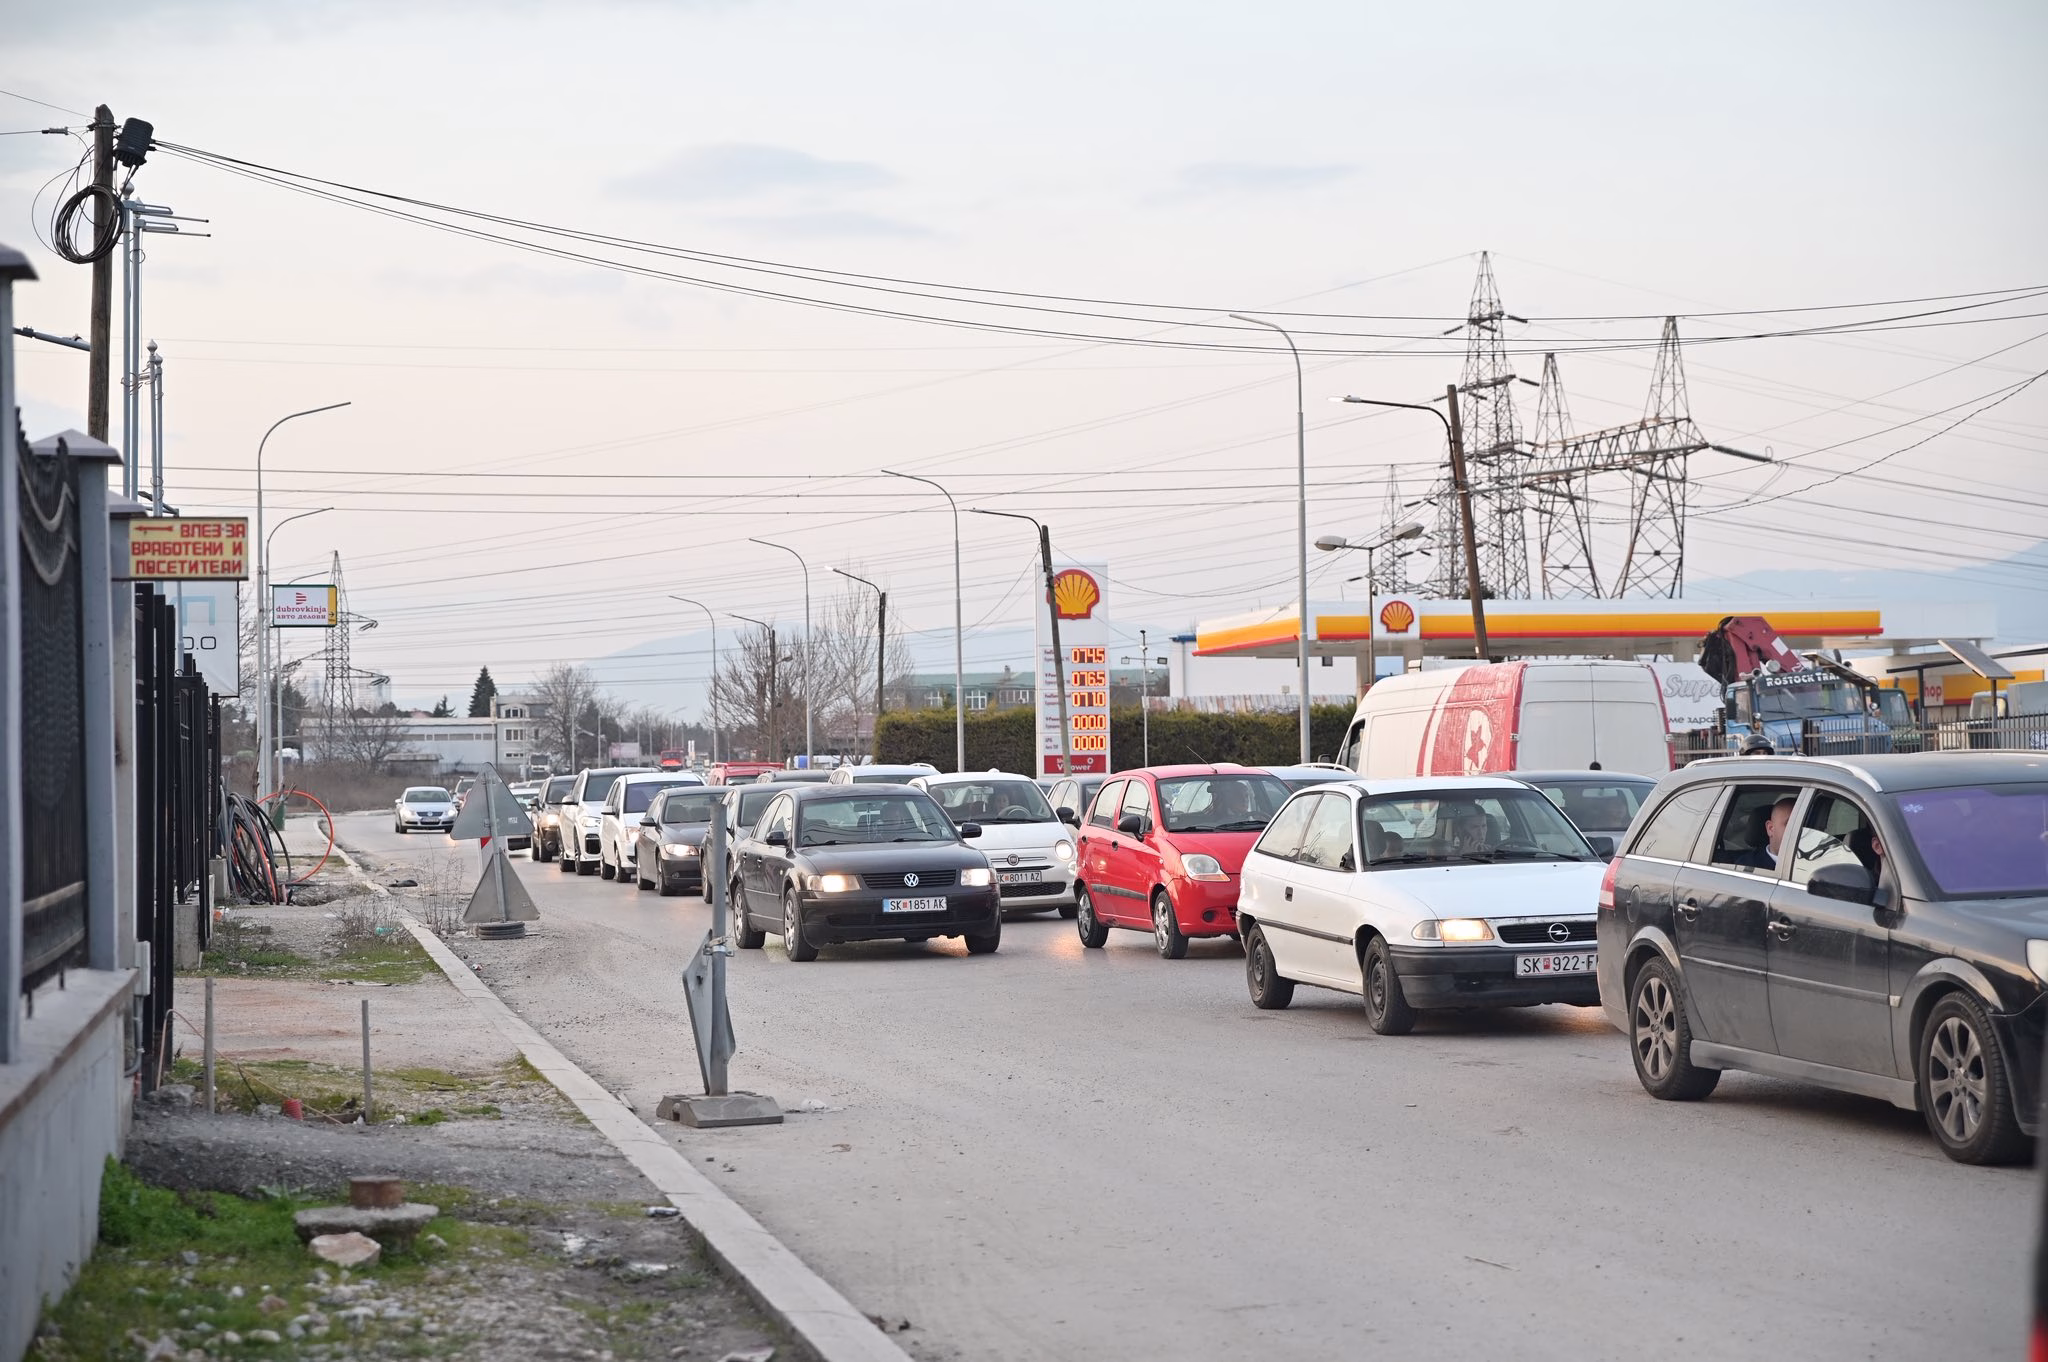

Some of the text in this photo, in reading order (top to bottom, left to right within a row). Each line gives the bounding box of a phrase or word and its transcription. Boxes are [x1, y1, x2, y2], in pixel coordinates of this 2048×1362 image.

[131, 541, 243, 556] ВРАБОТЕНИ И
[275, 605, 327, 614] dubrovkinja
[1766, 674, 1815, 687] ROSTOCK
[1663, 674, 1721, 703] Supe
[1924, 685, 1942, 702] hop
[1009, 873, 1028, 882] 8011
[1030, 872, 1040, 881] AZ
[890, 898, 945, 911] SK 1851 AK
[1523, 954, 1598, 973] SK 922-F
